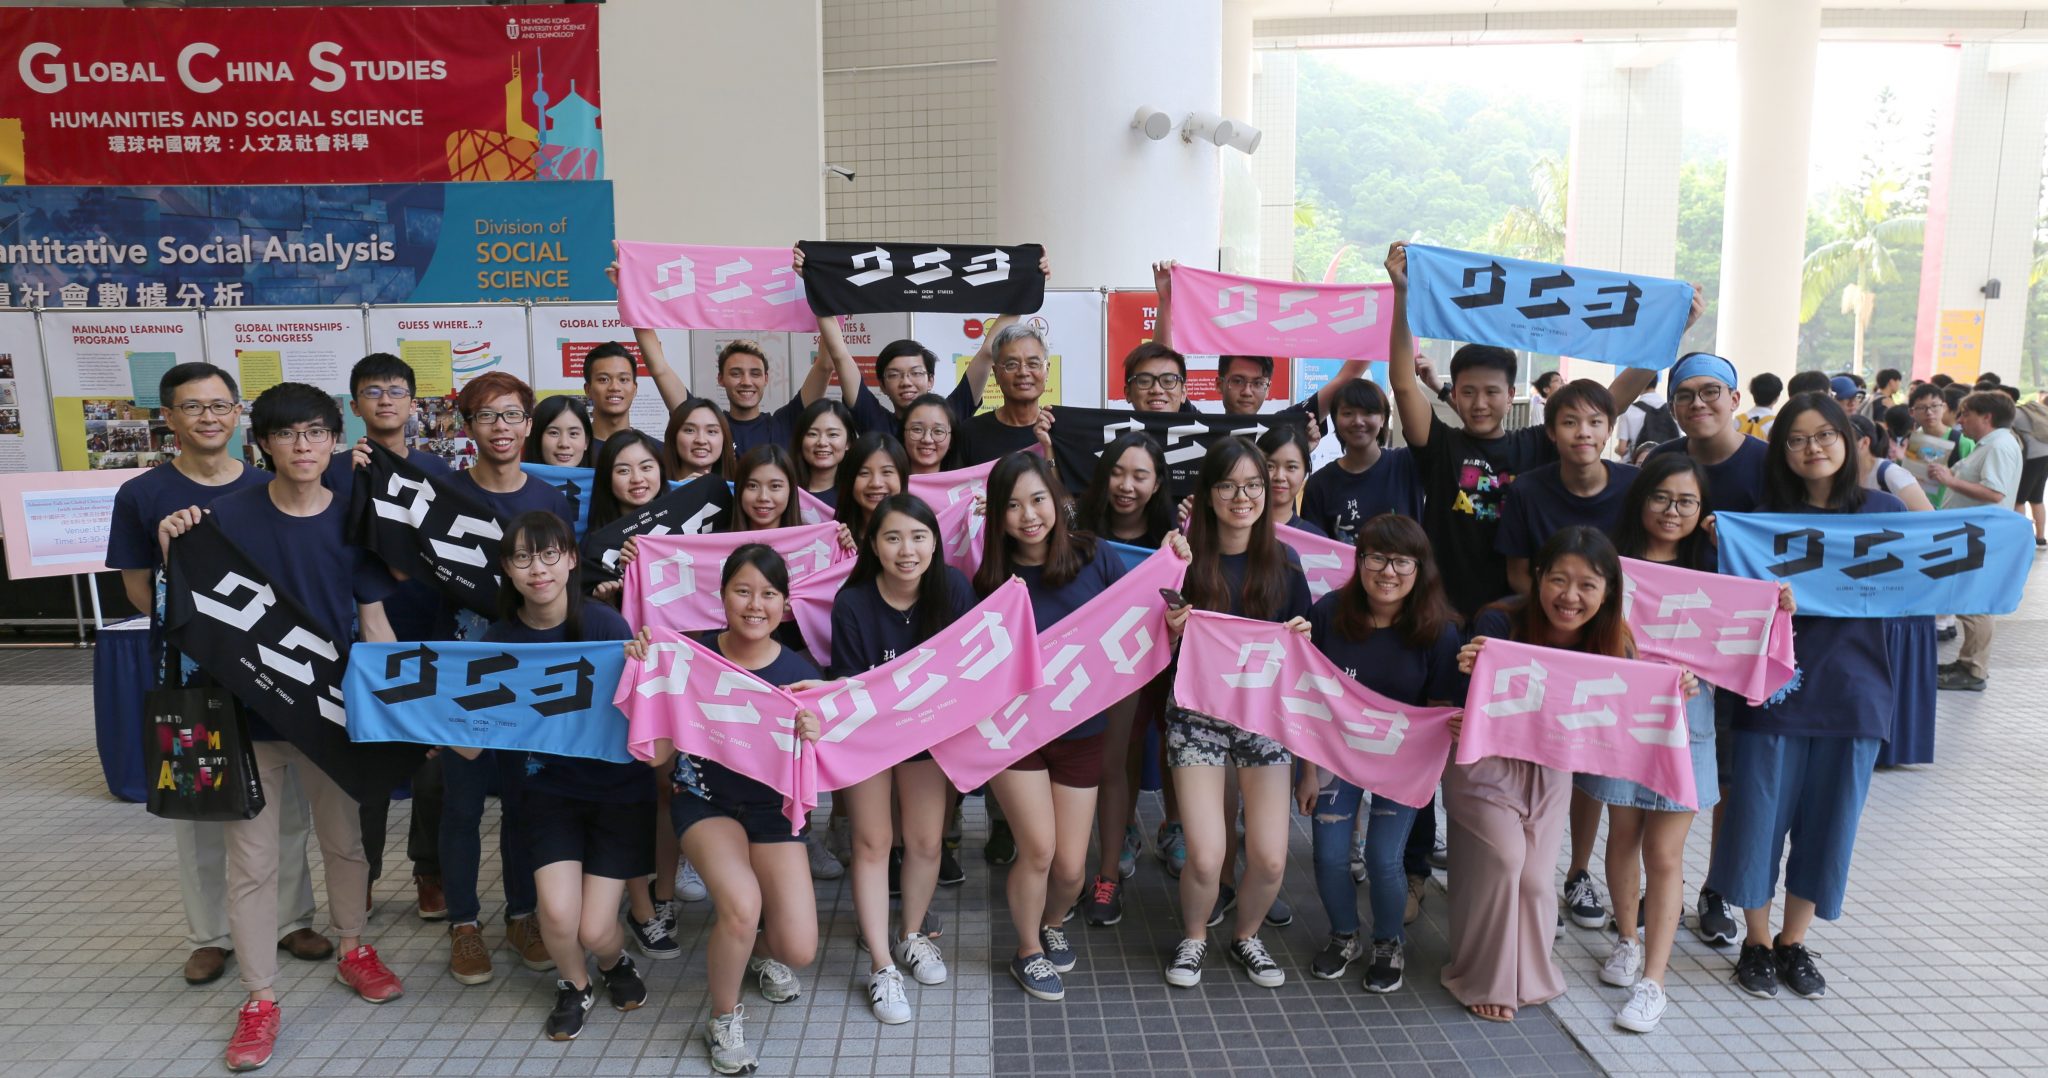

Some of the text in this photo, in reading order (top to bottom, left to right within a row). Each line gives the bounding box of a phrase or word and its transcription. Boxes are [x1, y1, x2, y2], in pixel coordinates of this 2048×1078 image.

[19, 41, 447, 94] GLOBAL CHINA STUDIES
[50, 109, 424, 129] HUMANITIES AND SOCIAL SCIENCE
[475, 218, 568, 236] Division of
[158, 236, 252, 265] Social
[262, 235, 395, 270] Analysis
[476, 242, 568, 263] SOCIAL
[477, 270, 569, 289] SCIENCE
[72, 324, 184, 334] MAINLAND LEARNING
[234, 323, 273, 333] GLOBAL
[276, 322, 344, 332] INTERNSHIPS
[398, 320, 483, 330] GUESS WHERE...?
[559, 319, 598, 329] GLOBAL
[73, 335, 130, 344] PROGRAMS
[235, 333, 313, 343] U.S. CONGRESS
[240, 657, 295, 705] GLOBAL CHINA STUDIES
